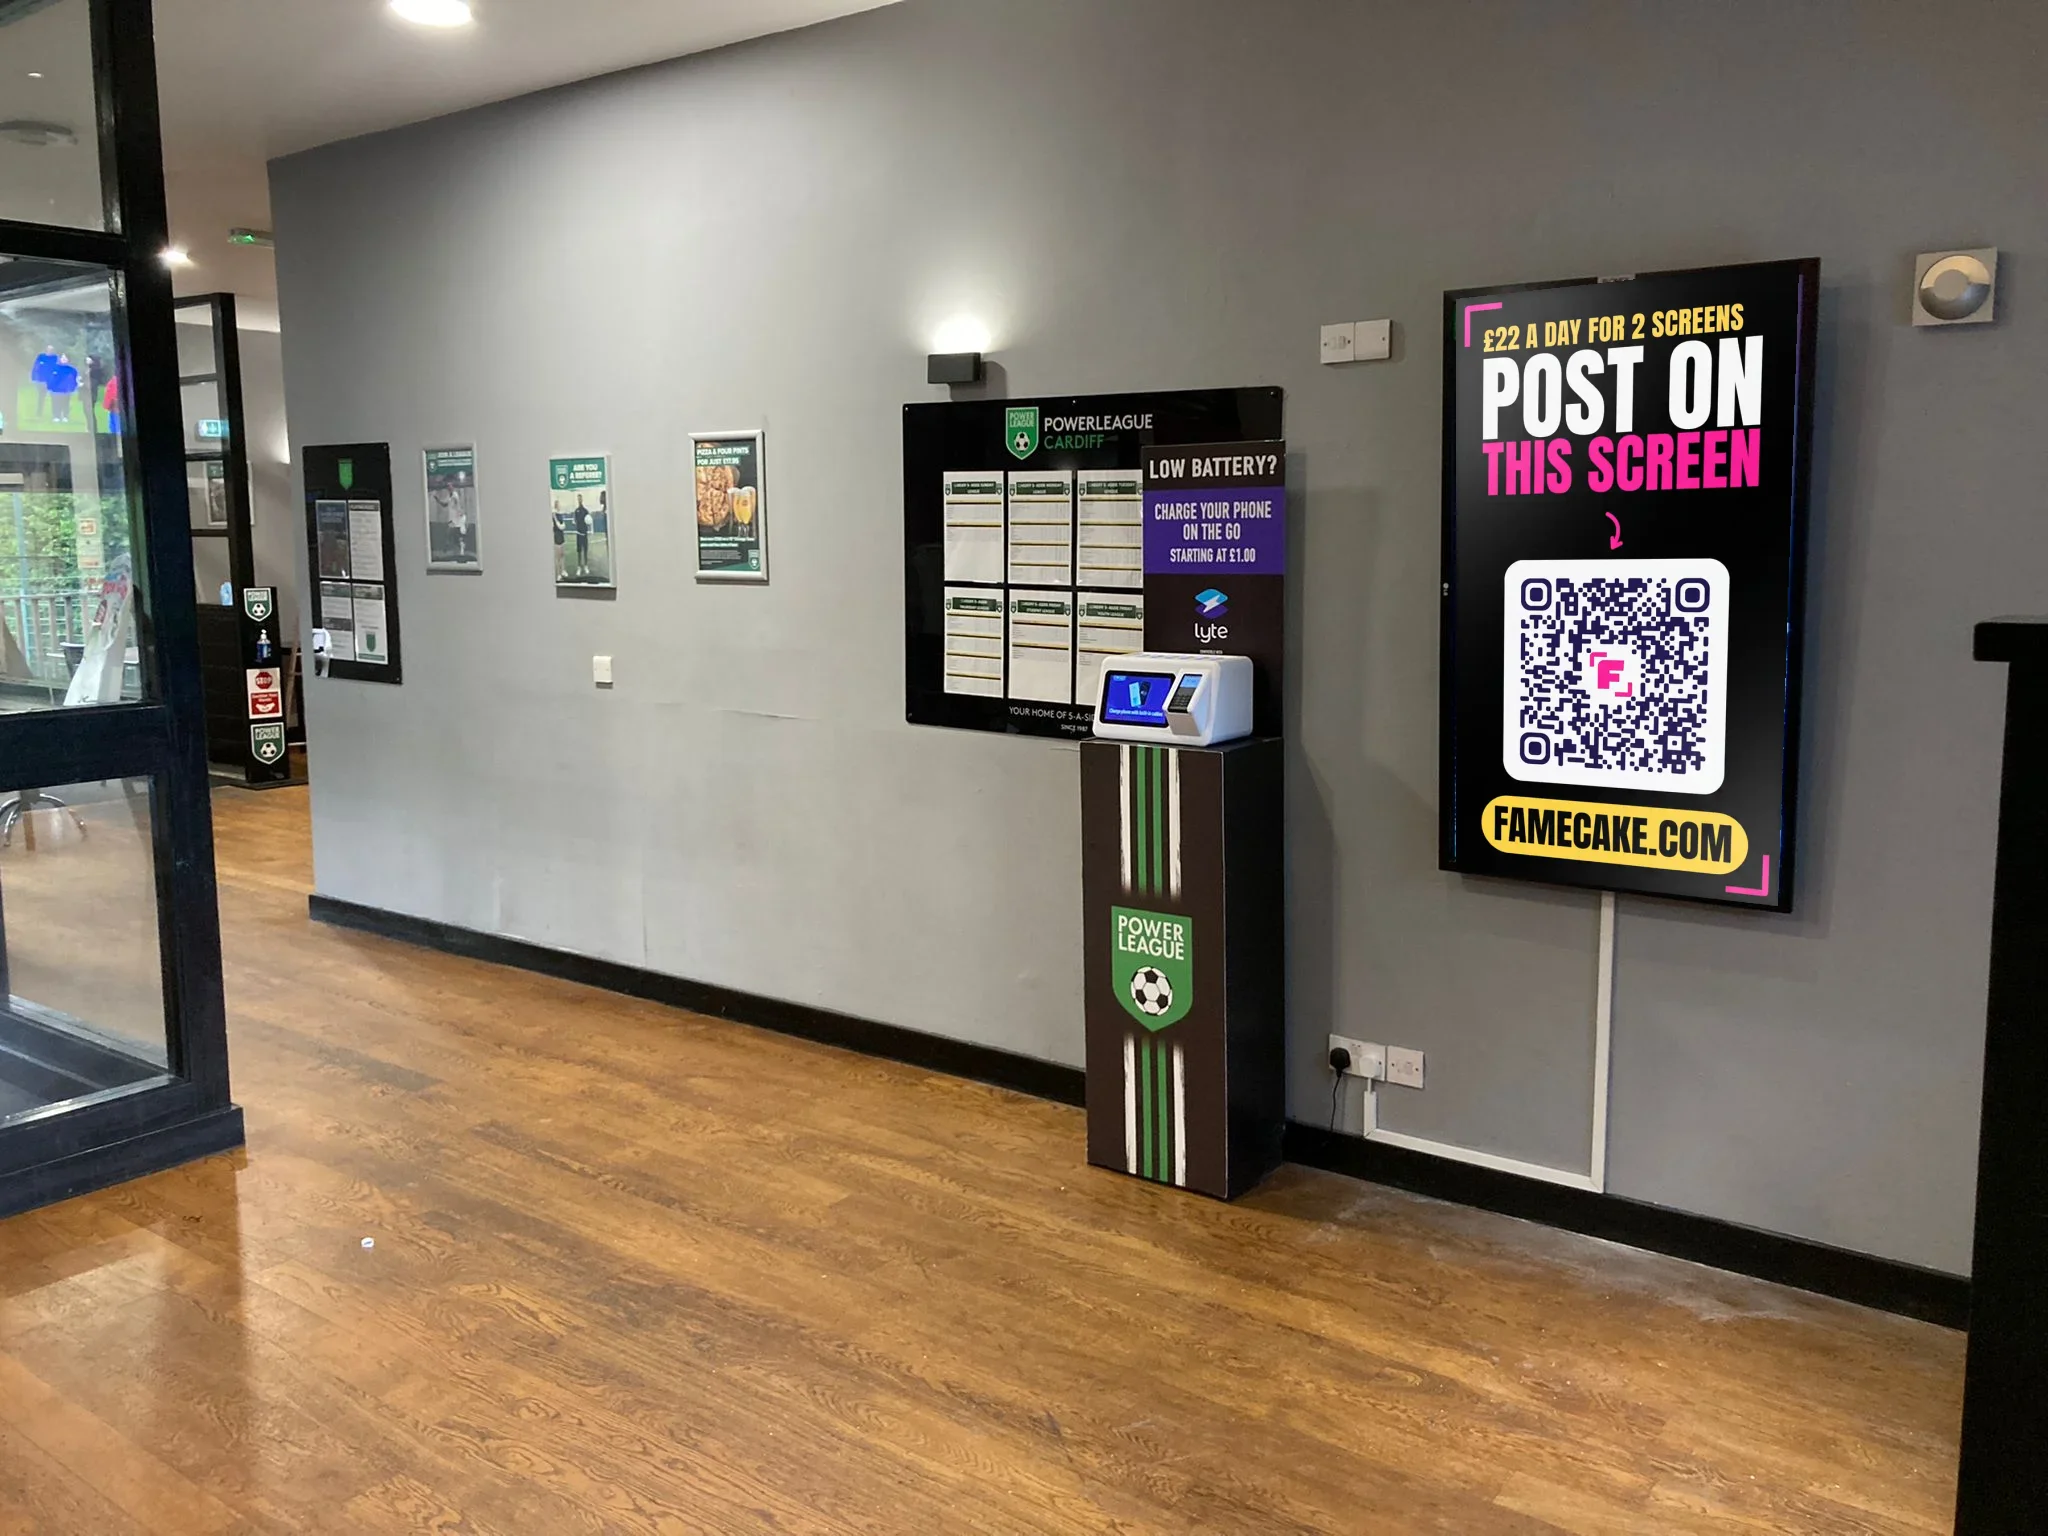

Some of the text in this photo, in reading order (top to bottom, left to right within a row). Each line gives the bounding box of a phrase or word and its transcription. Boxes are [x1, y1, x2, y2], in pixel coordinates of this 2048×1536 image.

[1483, 303, 1744, 353] £22 A DAY FOR 2 SCREENS
[1482, 335, 1764, 440] POST ON
[1009, 412, 1035, 420] POWER
[1009, 420, 1035, 428] LEAGUE
[1044, 414, 1153, 432] POWERLEAGUE
[696, 448, 712, 456] PIZZA
[717, 447, 732, 455] FOUR
[1044, 434, 1105, 449] CARDIFF
[1149, 454, 1278, 479] LOW BATTERY?
[1482, 428, 1761, 496] THIS SCREEN
[1154, 500, 1272, 520] CHARGE YOUR PHONE
[1183, 522, 1241, 540] ON THE GO
[1170, 548, 1256, 563] STARTING AT £1.00
[1194, 622, 1229, 644] lyte
[1597, 660, 1624, 689] F
[1009, 706, 1095, 722] YOUR HOME OF 5-A-SID
[1061, 724, 1076, 732] SINCE
[1494, 805, 1732, 864] FAMECAKE.COM
[1118, 914, 1184, 942] POWER
[1118, 932, 1185, 960] LEAGUE
